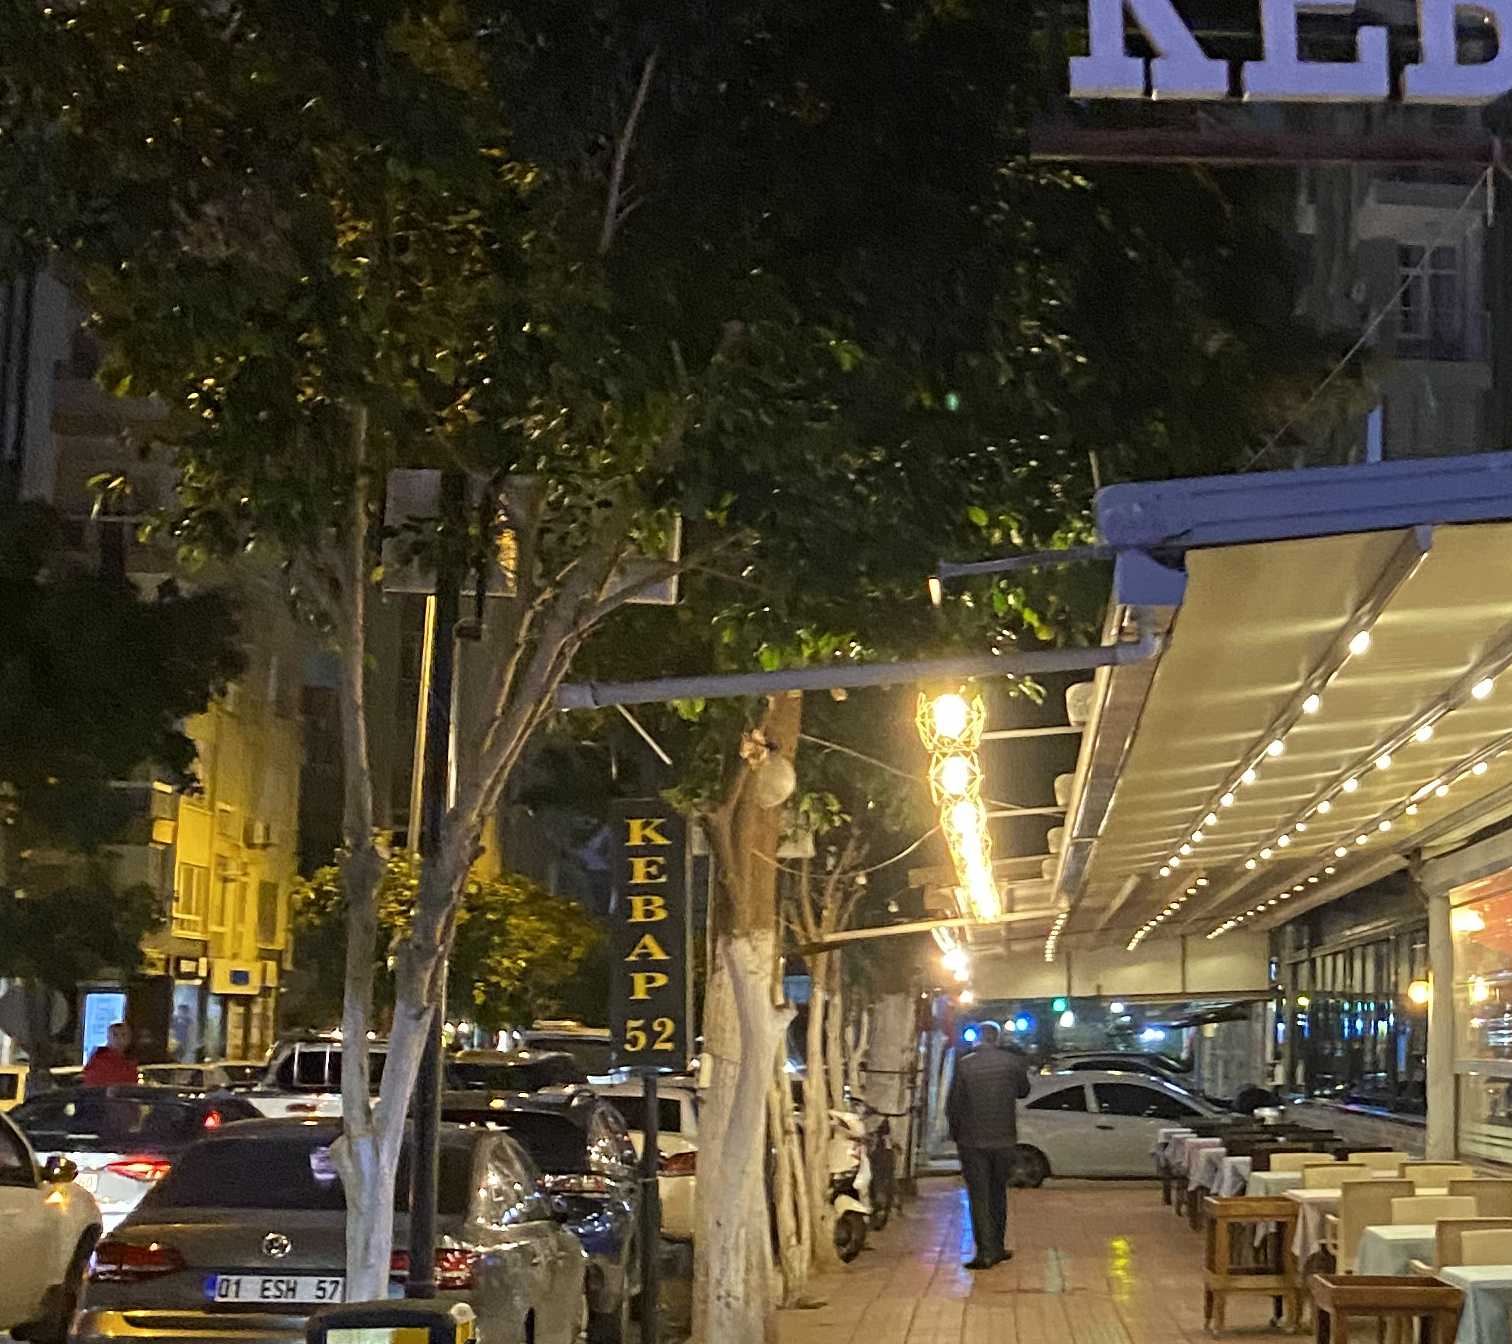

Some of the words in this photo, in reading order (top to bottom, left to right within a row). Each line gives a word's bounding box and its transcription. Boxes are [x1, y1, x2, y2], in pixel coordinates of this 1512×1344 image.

[624, 817, 673, 1001] KEBAP
[623, 1017, 676, 1052] 52
[218, 1278, 241, 1299] 01
[259, 1278, 298, 1300] ESH
[314, 1279, 340, 1301] 57
